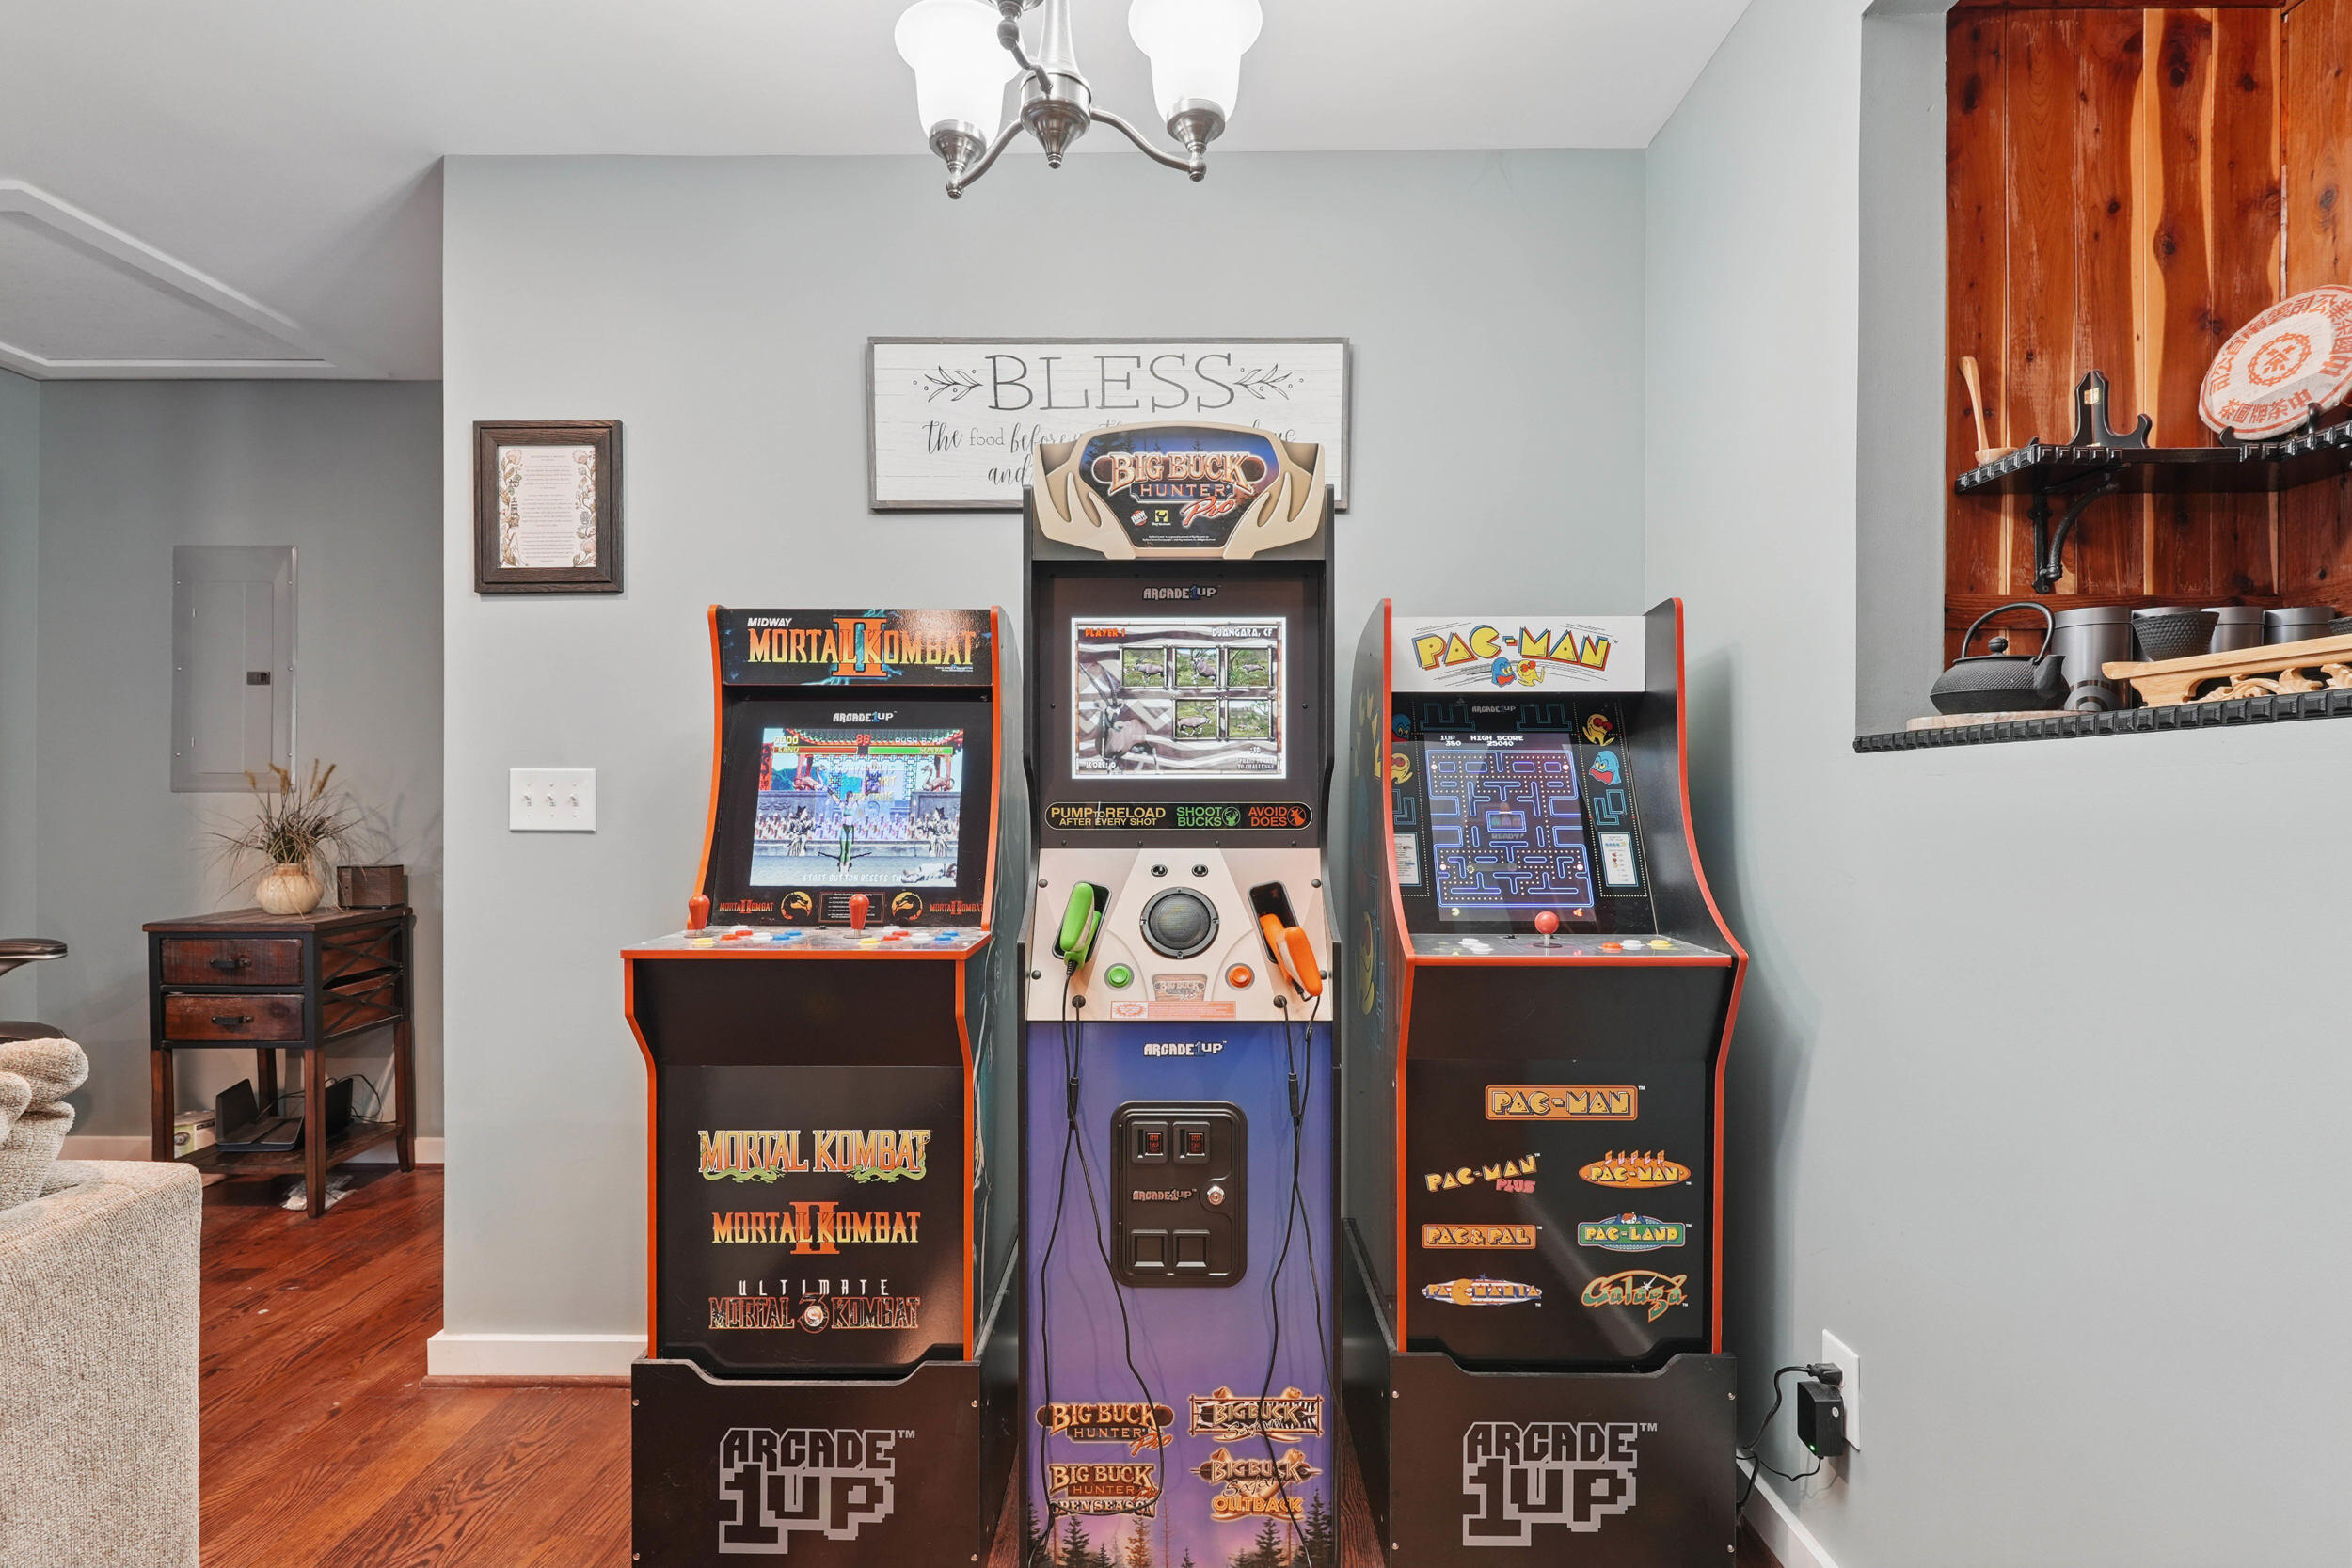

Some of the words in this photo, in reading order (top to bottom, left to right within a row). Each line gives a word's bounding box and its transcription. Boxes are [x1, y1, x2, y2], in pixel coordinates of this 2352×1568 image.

[984, 353, 1235, 412] BLESS
[922, 420, 962, 454] the
[970, 427, 1005, 446] food
[988, 454, 1029, 486] and
[1108, 452, 1164, 496] BIG
[1168, 451, 1254, 494] BUCK
[1140, 484, 1226, 497] HUNTER
[1180, 496, 1235, 527] Pro
[1142, 586, 1216, 599] ARCADE1UP
[747, 617, 792, 627] MIDWAY
[1085, 627, 1119, 637] PLAYER
[747, 628, 858, 664] MORTAL
[862, 630, 977, 665] KOMBAT
[833, 618, 888, 677] II
[1411, 625, 1612, 672] PAC-MAN
[833, 711, 894, 722] ARCADE1UP
[1051, 807, 1092, 818] PUMP
[1105, 807, 1166, 818] RELOAD
[1176, 806, 1222, 816] SHOOT
[1177, 816, 1222, 827] BUCKS
[1248, 806, 1287, 816] AVOID
[1251, 816, 1287, 827] DOES
[829, 874, 858, 882] BUTTON
[861, 874, 888, 882] RESETS
[746, 902, 774, 911] KOMBAT
[1144, 1041, 1223, 1057] ARCADE1UP
[1492, 1091, 1631, 1115] PAC-MAN
[698, 1130, 809, 1173] MORTAL
[813, 1130, 931, 1173] KOMBAT
[1604, 1149, 1665, 1164] SUPER
[1425, 1154, 1537, 1193] PAC-MAN
[1590, 1165, 1679, 1181] PAC-MAN
[1132, 1189, 1193, 1201] ARCADE1UP
[1496, 1178, 1536, 1194] PLUS
[712, 1212, 813, 1243] MORTAL
[817, 1212, 920, 1243] KOMBAT
[789, 1201, 840, 1254] II
[1427, 1227, 1469, 1245] PAC
[1470, 1227, 1486, 1245] &
[1488, 1227, 1531, 1245] PAL
[1584, 1226, 1678, 1243] PAC-LAND
[739, 1279, 889, 1295] ULTIMATE
[708, 1297, 795, 1329] MORTAL
[798, 1292, 829, 1334] 3
[831, 1297, 920, 1329] KOMBAT
[1049, 1402, 1092, 1435] BIG
[1096, 1402, 1159, 1431] BUCK
[1212, 1403, 1246, 1427] BIG
[1248, 1403, 1301, 1426] BUCK
[1073, 1428, 1142, 1438] HUNTER
[719, 1428, 895, 1473] ARCADE
[1129, 1433, 1173, 1456] Pro
[1463, 1422, 1637, 1467] ARCADE
[1049, 1465, 1091, 1497] BIG
[1094, 1464, 1157, 1493] BUCK
[1211, 1460, 1246, 1484] BIG
[1073, 1485, 1136, 1495] HUNTER
[1222, 1475, 1280, 1497] Safar
[719, 1462, 895, 1554] 1UP
[1049, 1498, 1090, 1518] OPEN
[1093, 1497, 1158, 1517] SEASON
[1212, 1496, 1303, 1514] OUTBACK
[1463, 1456, 1637, 1546] 1UP
